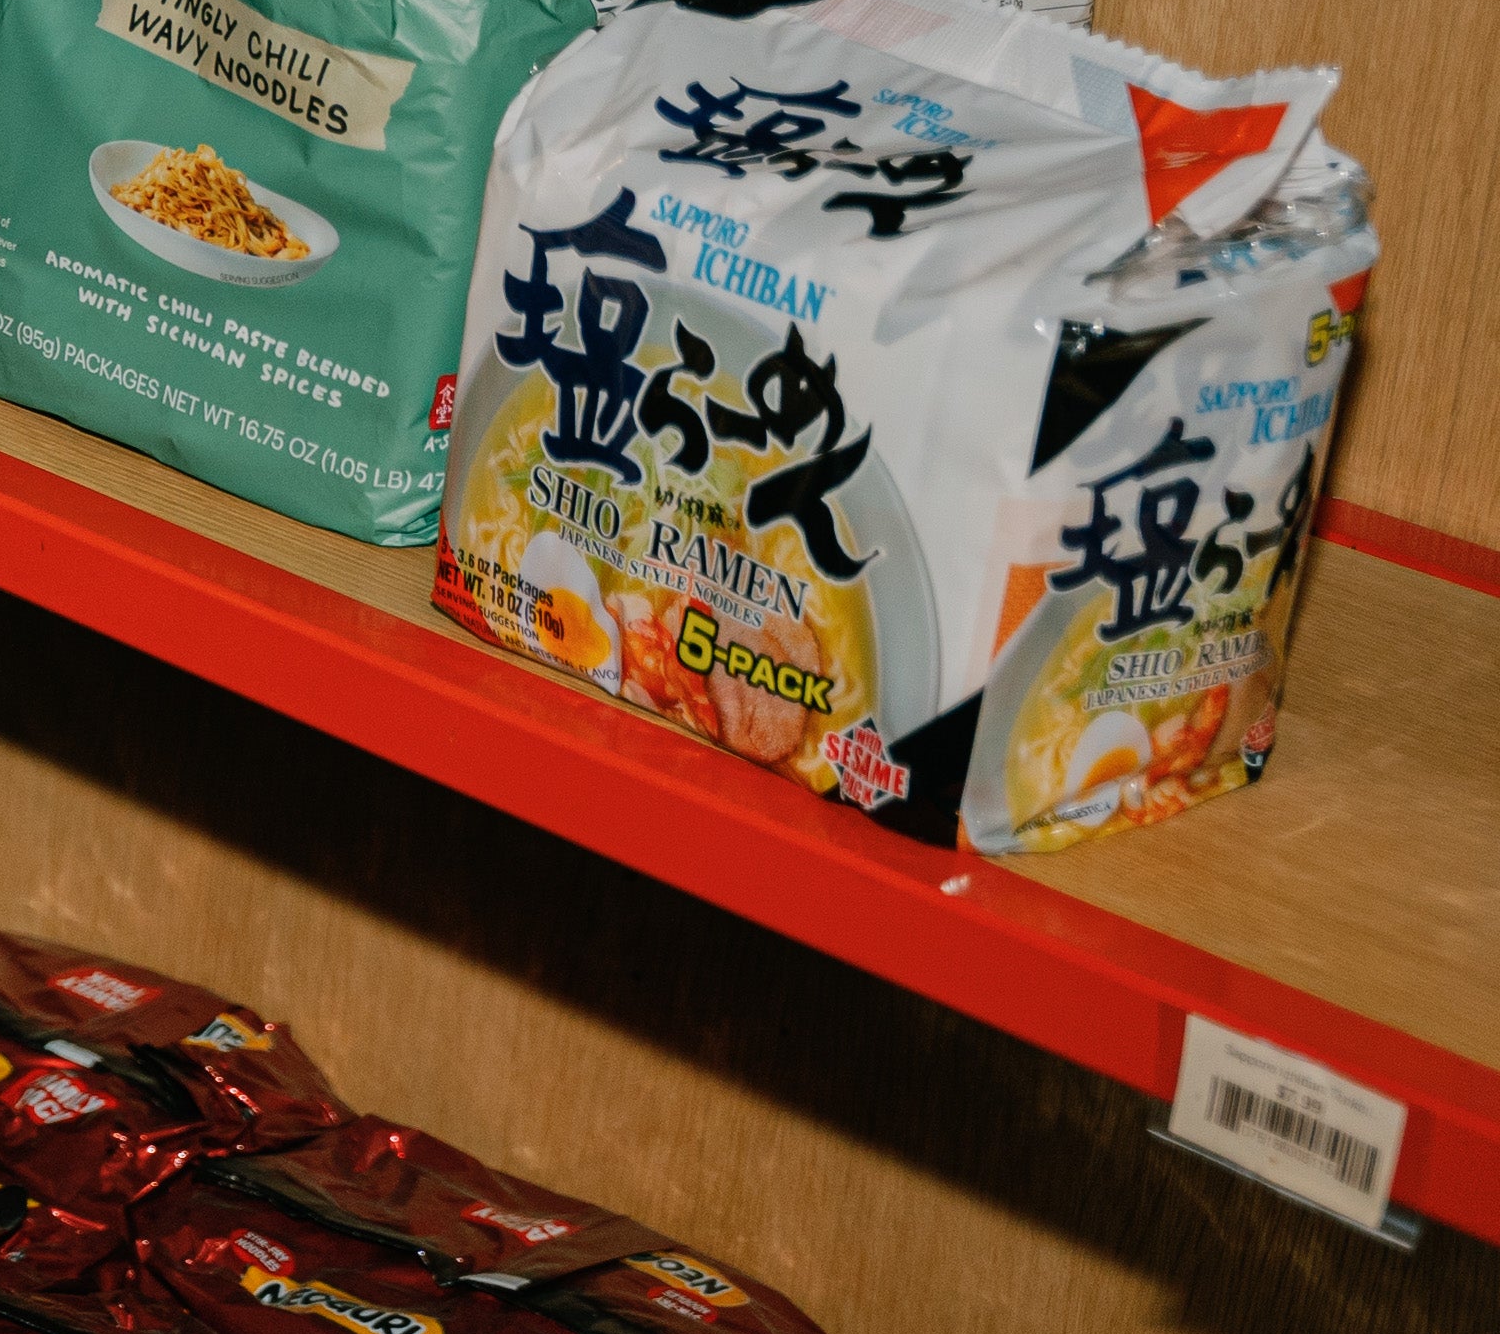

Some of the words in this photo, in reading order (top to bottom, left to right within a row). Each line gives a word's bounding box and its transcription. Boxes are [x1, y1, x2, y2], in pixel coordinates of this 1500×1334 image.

[128, 2, 210, 67] WAVY
[213, 50, 350, 136] NOODLES
[247, 30, 332, 88] CHILI
[650, 193, 750, 250] SAPPORO
[44, 249, 149, 303] AROMATIC
[157, 292, 213, 329] CHILI
[222, 319, 289, 360] PASTE
[296, 349, 391, 400] BLENDED
[691, 241, 828, 324] ICHIBAN
[77, 286, 132, 323] WITH
[145, 313, 248, 370] SICHUAN
[258, 362, 343, 410] SPICES
[16, 321, 62, 363] (95g)
[63, 342, 161, 402] PACKAGES
[162, 384, 201, 418] NET
[202, 400, 235, 432] WT
[238, 413, 286, 453] 16.75
[288, 435, 319, 467] OZ
[320, 446, 370, 490] (1.05
[373, 467, 415, 496] LB)
[1196, 374, 1300, 414] SAPPORO
[492, 558, 555, 609] Packages
[528, 465, 622, 541] SHIO
[646, 519, 810, 622] RAMEN
[558, 524, 625, 570] JAPANESE
[628, 558, 687, 595] STYLE
[691, 579, 765, 630] NOODLES
[438, 557, 461, 587] NET
[463, 572, 487, 600] WT.
[523, 598, 566, 642] (510g)
[675, 604, 834, 714] 5-PACK
[1082, 681, 1170, 711] JAPANESE
[1172, 670, 1224, 704] STYLE
[1107, 649, 1185, 685] SHIO
[824, 730, 909, 799] SESAME
